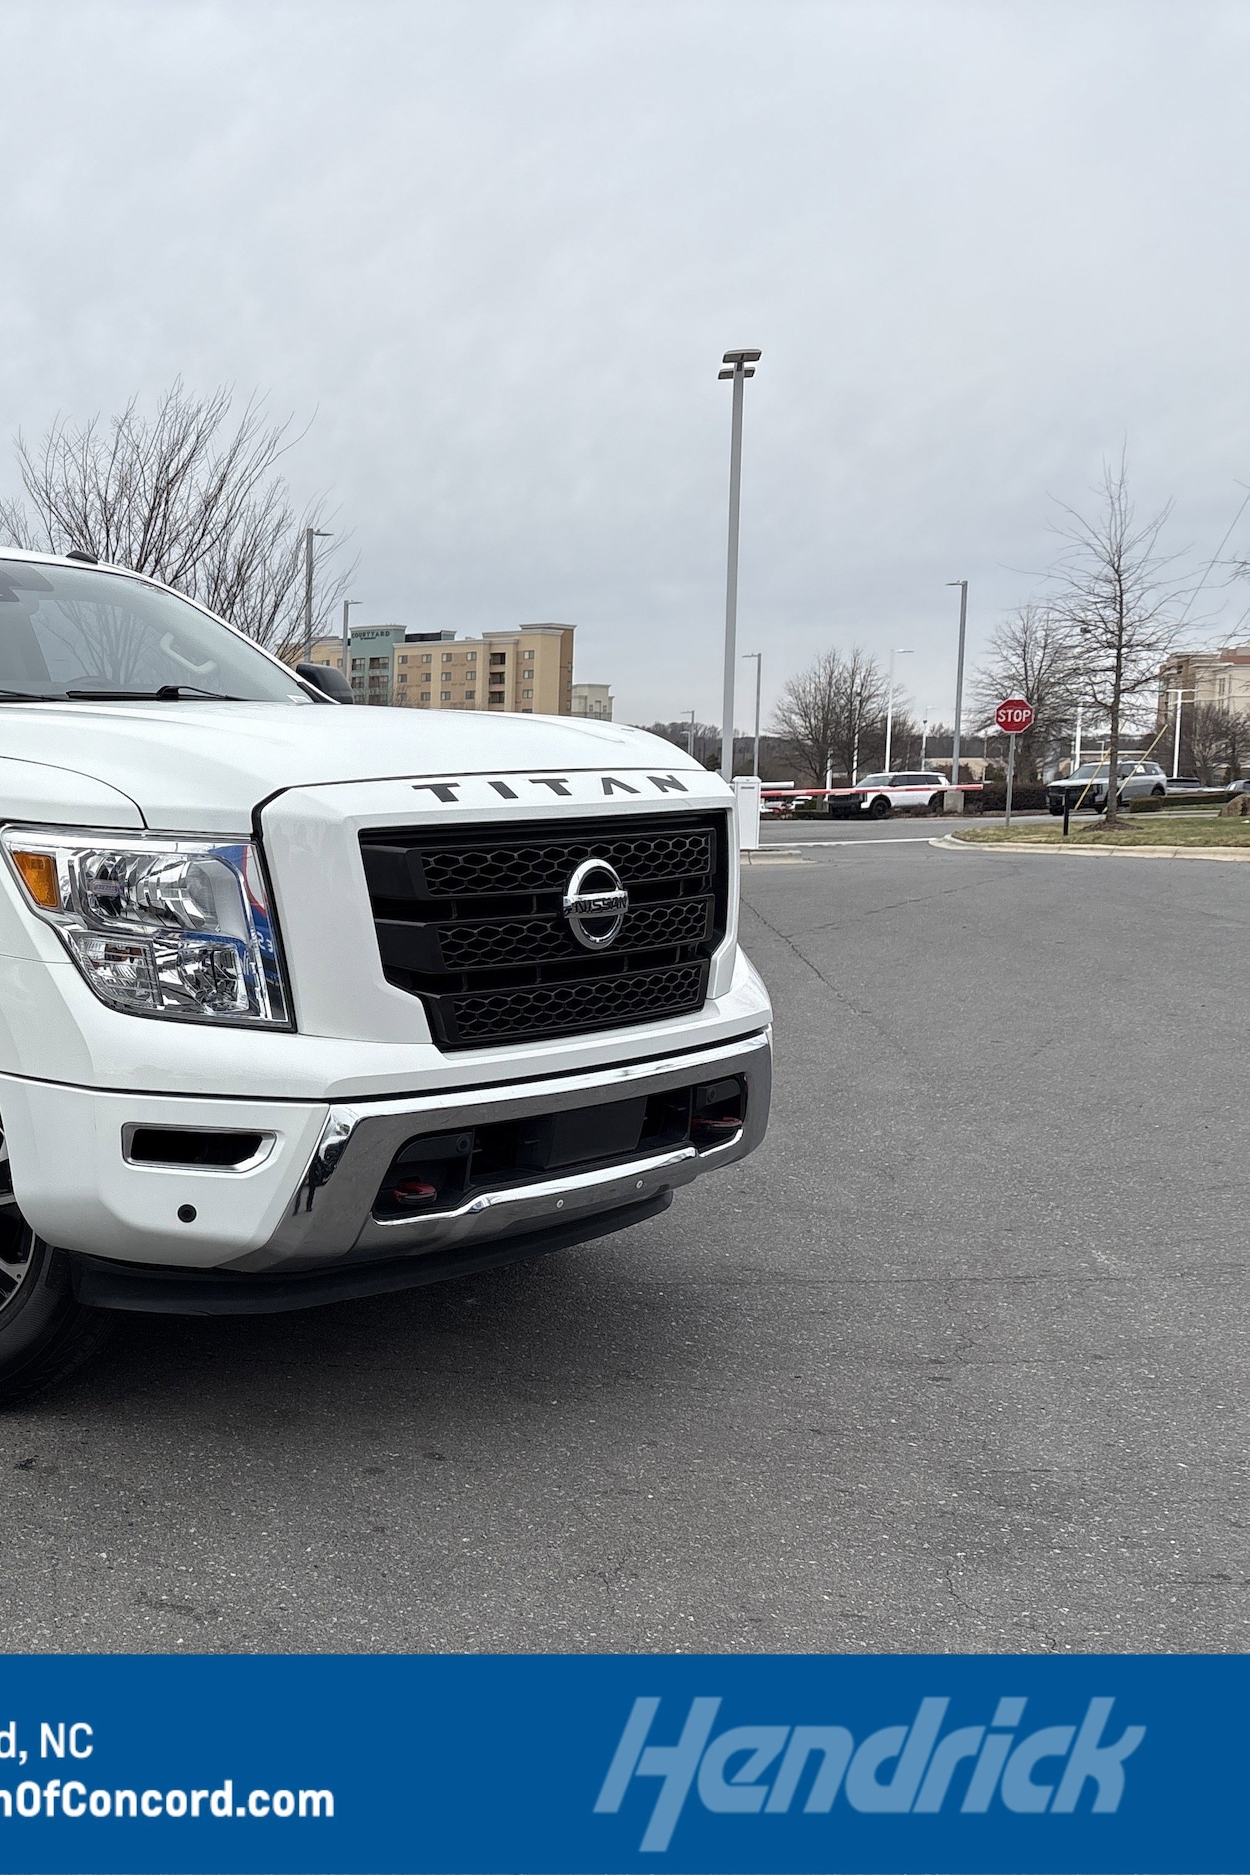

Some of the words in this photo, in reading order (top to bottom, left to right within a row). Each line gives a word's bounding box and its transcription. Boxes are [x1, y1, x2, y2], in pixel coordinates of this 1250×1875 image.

[351, 631, 391, 639] COURTYARD
[997, 709, 1032, 723] STOP
[411, 774, 689, 803] TITAN
[574, 896, 627, 914] NISSAN
